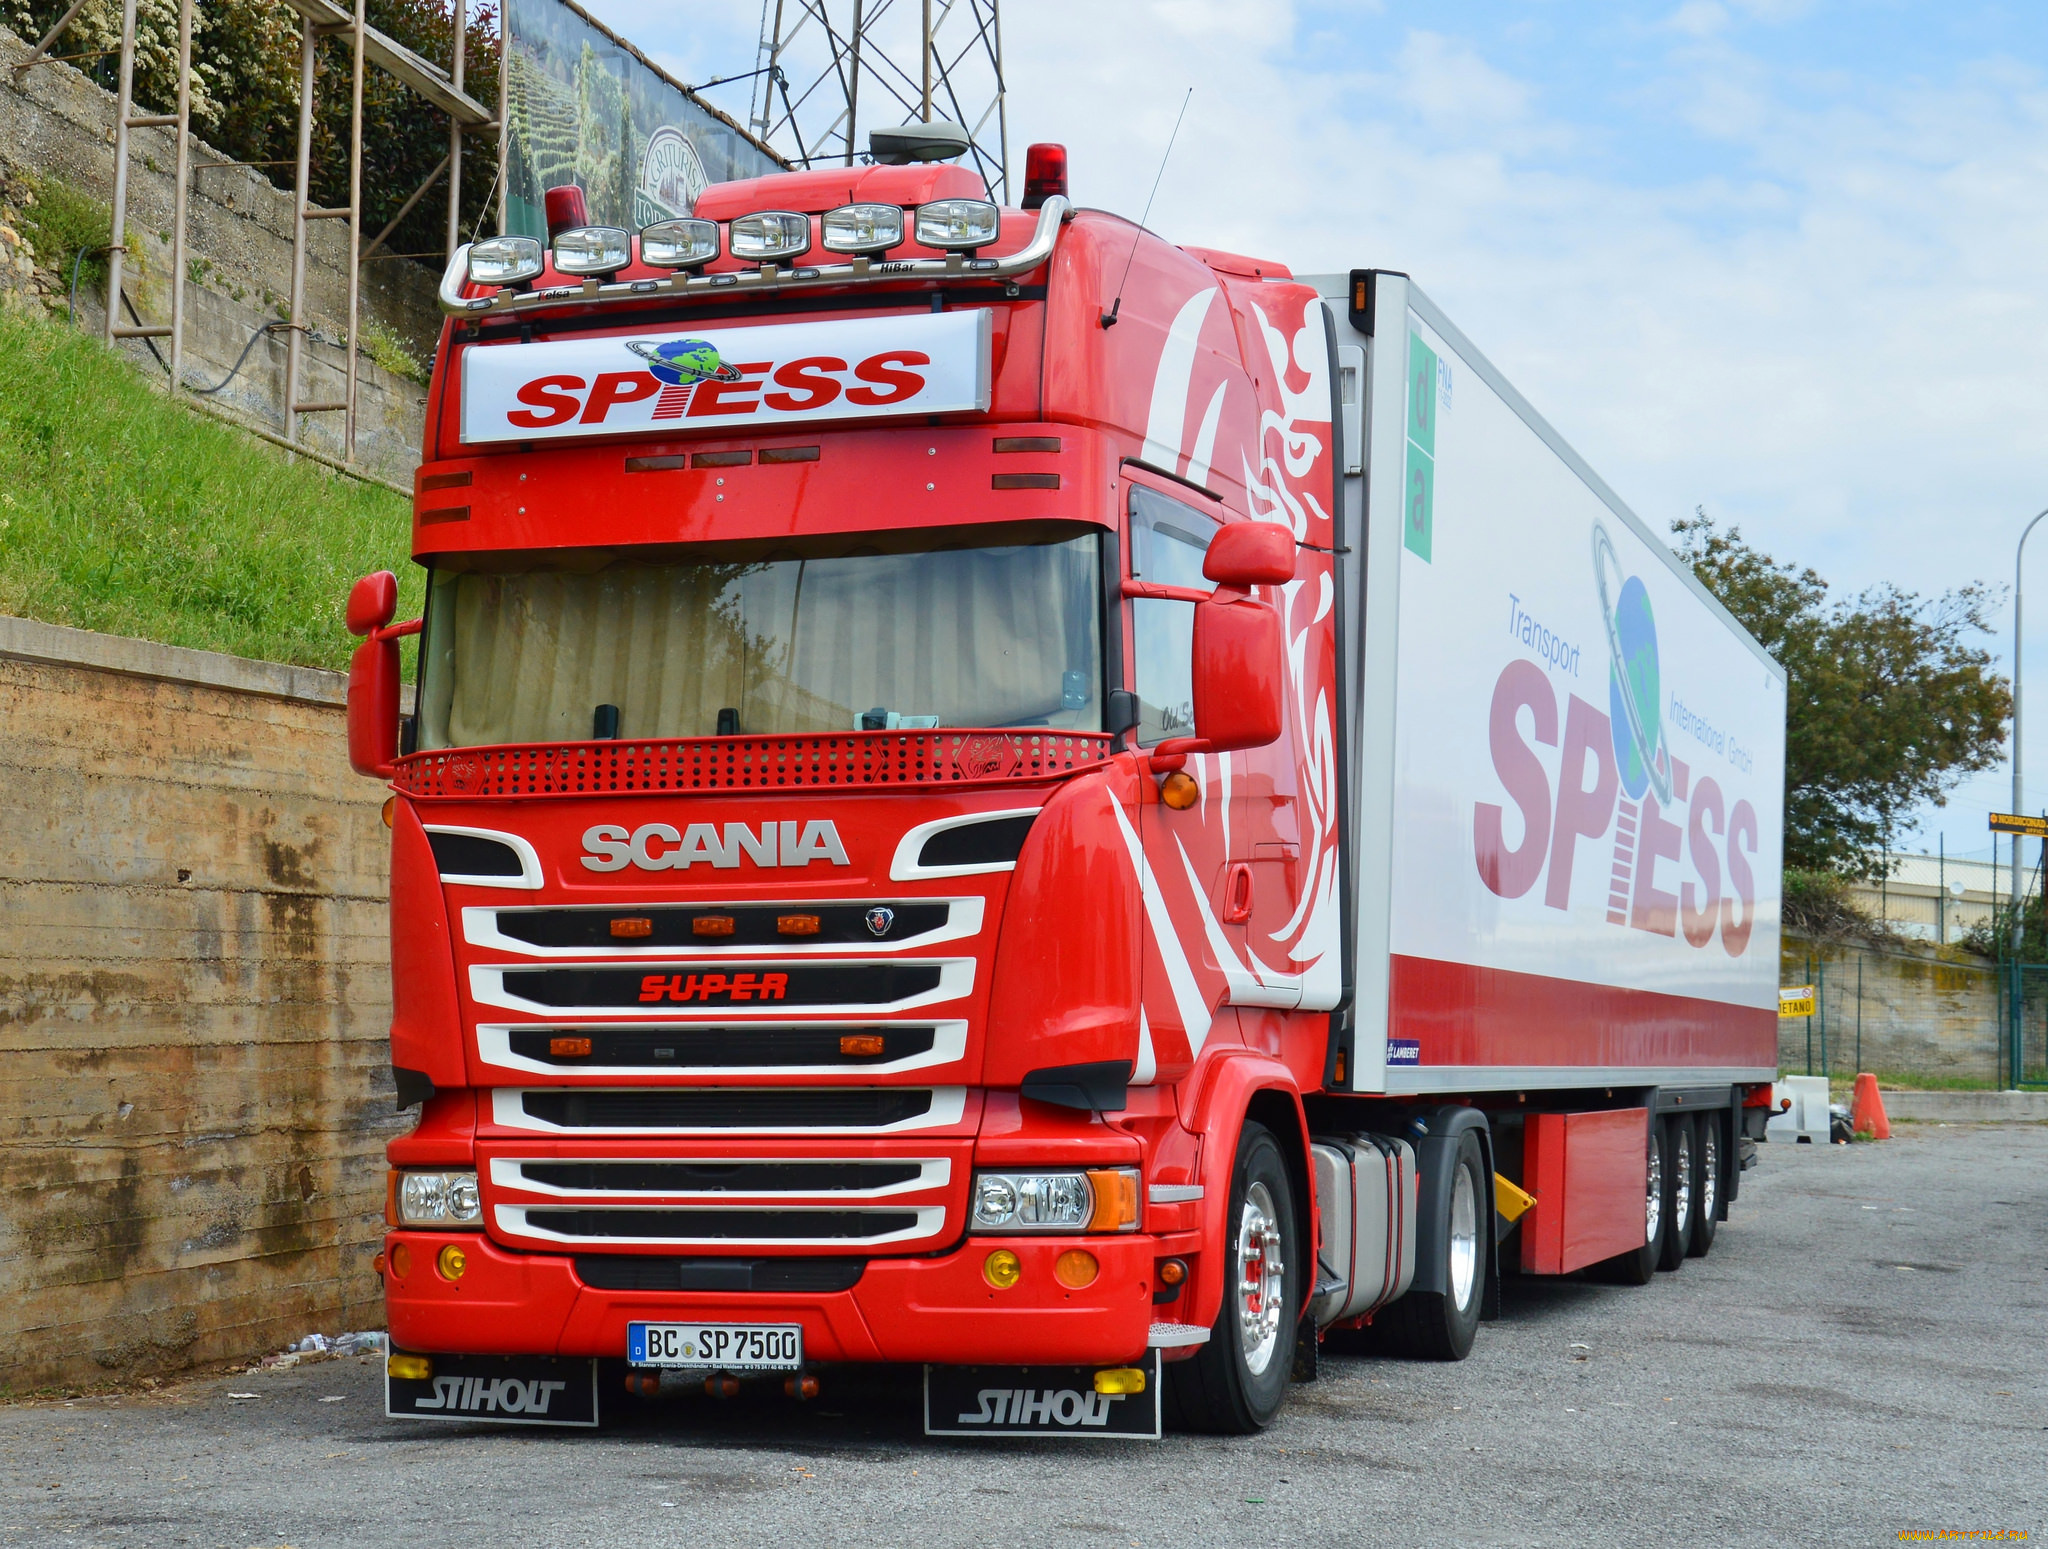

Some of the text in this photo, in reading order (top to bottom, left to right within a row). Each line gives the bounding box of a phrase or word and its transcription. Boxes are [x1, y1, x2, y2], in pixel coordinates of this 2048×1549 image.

[880, 263, 915, 273] HiBar
[537, 289, 570, 301] Kelsa
[507, 350, 930, 428] SPIESS
[1509, 592, 1580, 678] Transport
[1670, 690, 1753, 776] International GmbH
[1474, 659, 1758, 958] SPIESS
[580, 819, 851, 872] SCANIA
[638, 973, 789, 1002] SUPER
[1393, 1047, 1419, 1059] LAMBERET
[635, 1347, 641, 1355] D
[648, 1329, 796, 1360] BC SP 7500
[415, 1376, 566, 1414] STIHOLT
[957, 1389, 1126, 1426] STIHOLT
